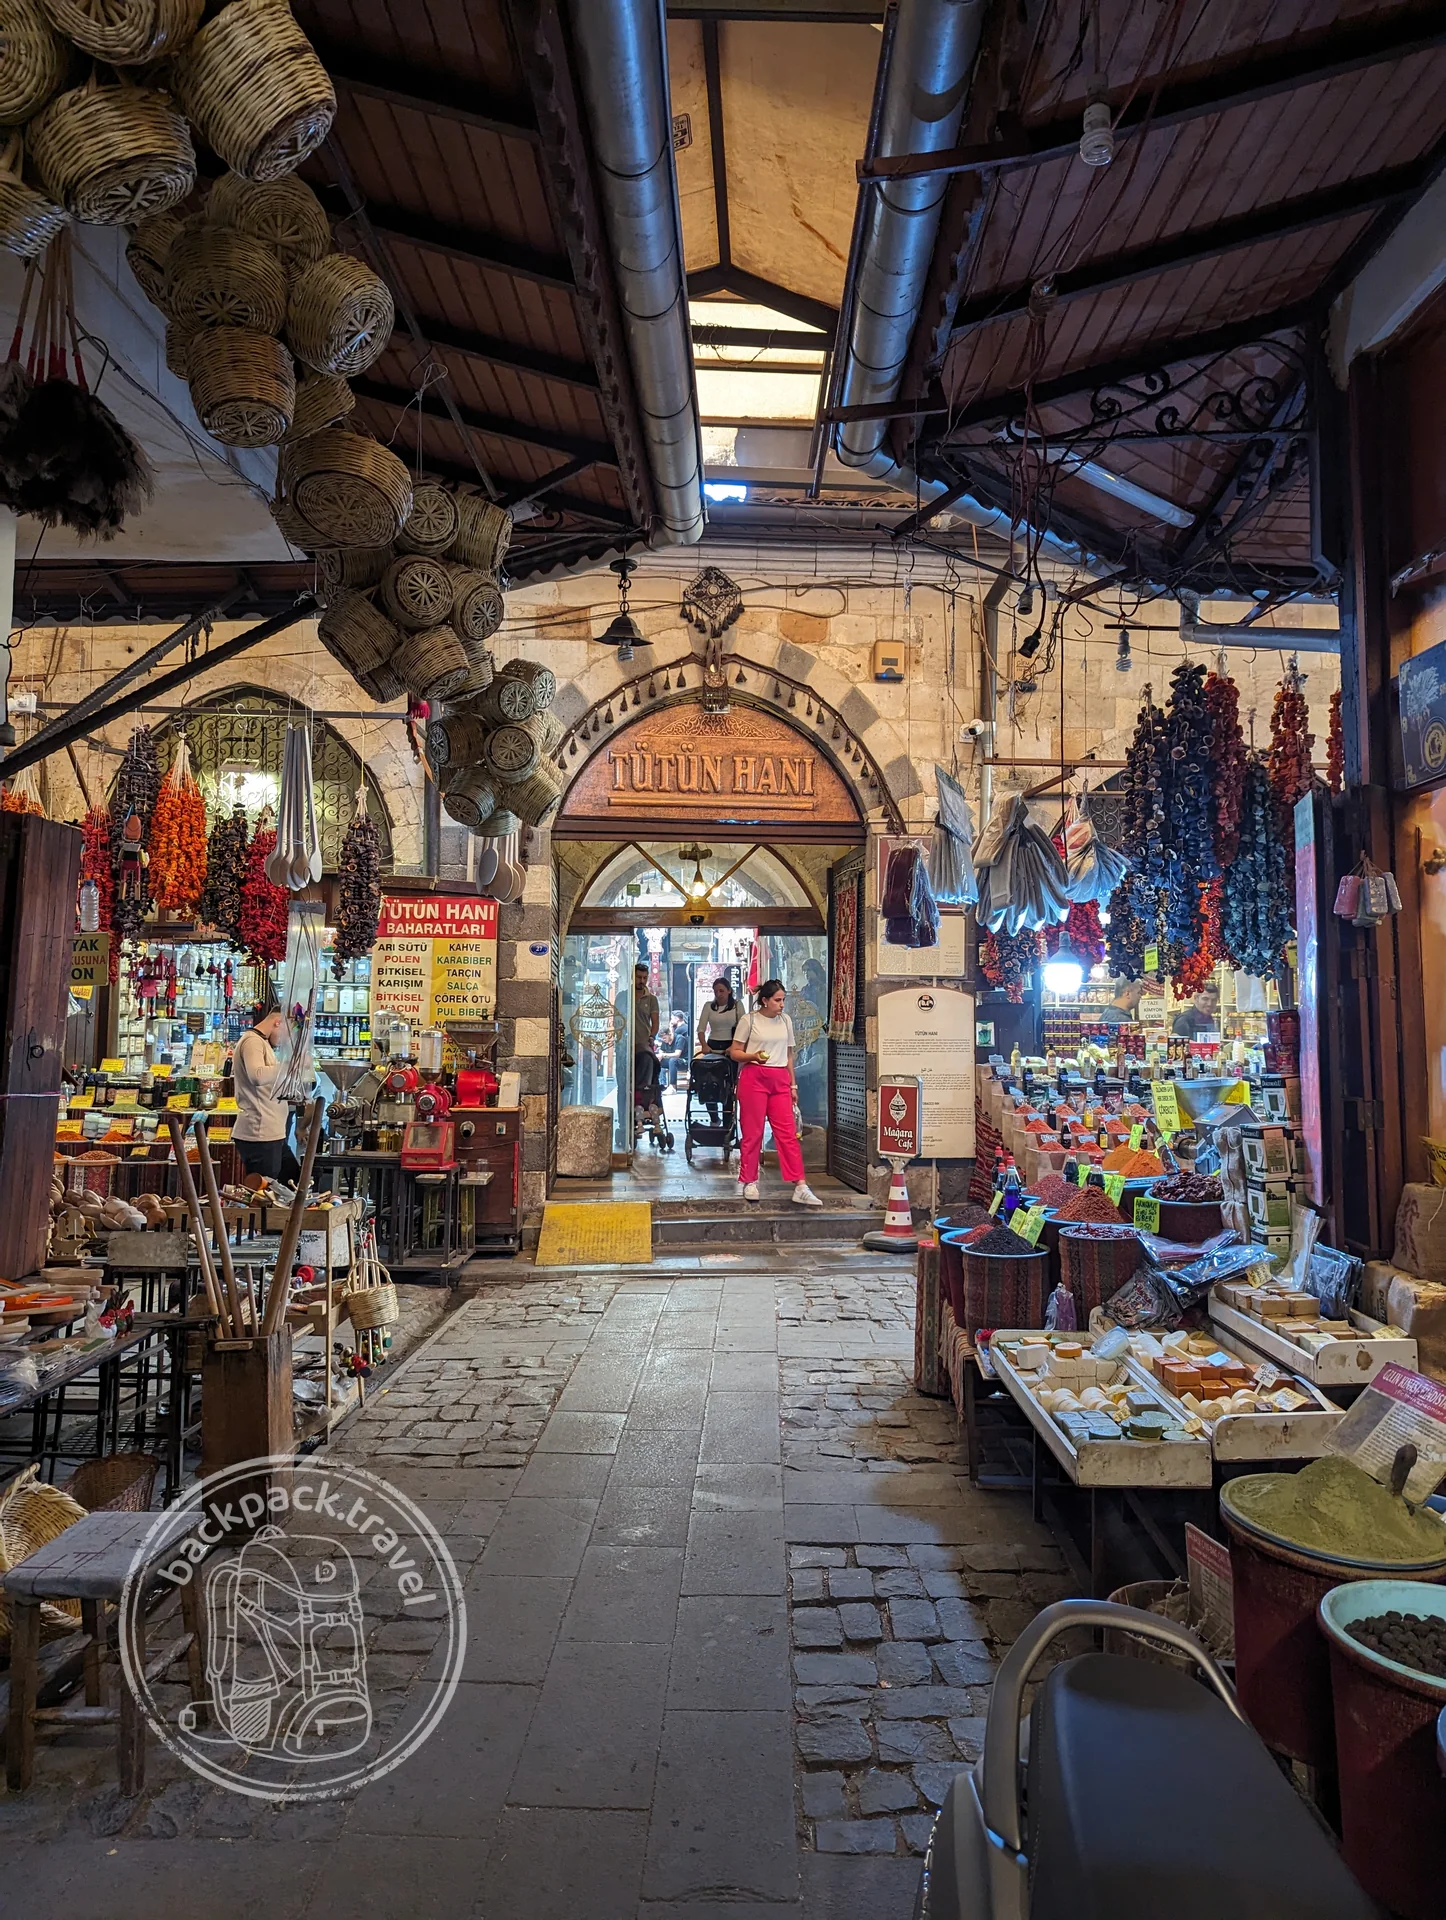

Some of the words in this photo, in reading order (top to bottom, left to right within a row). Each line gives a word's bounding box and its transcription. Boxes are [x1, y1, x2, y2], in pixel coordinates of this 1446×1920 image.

[608, 741, 723, 793] TÜTÜN
[731, 755, 815, 796] HANI
[446, 904, 495, 921] HANI
[386, 923, 485, 936] BAHARATLARI
[377, 943, 395, 952] ARI
[398, 942, 428, 952] SÜTÜ
[449, 943, 481, 952] KAHVE
[384, 955, 420, 964] POLEN
[436, 954, 492, 966] KARABİBER
[377, 966, 426, 977] BİTKİSEL
[446, 968, 482, 978] TARÇIN
[378, 979, 423, 990] KARIŞIM
[447, 982, 479, 992] SALÇA
[376, 992, 425, 1002] BİTKİSEL
[434, 993, 469, 1004] ÇÖREK
[471, 995, 491, 1004] OTU
[436, 1007, 456, 1016] PUL
[458, 1006, 488, 1016] BİBER
[883, 1126, 914, 1142] Mağara
[897, 1139, 913, 1152] Cafe
